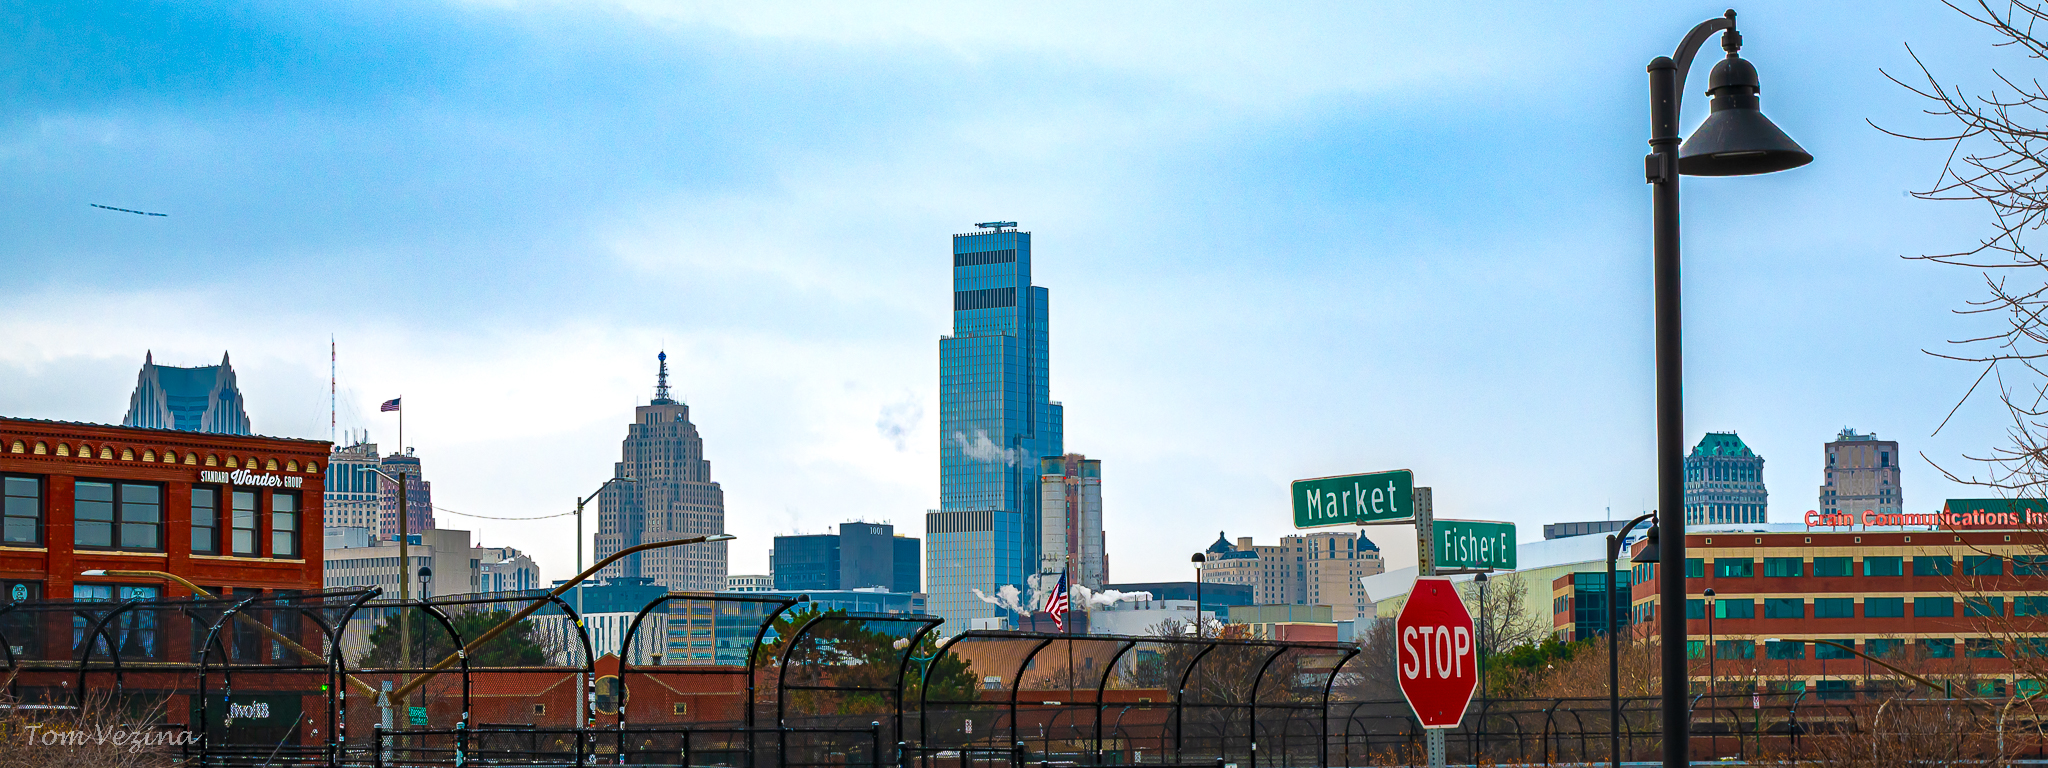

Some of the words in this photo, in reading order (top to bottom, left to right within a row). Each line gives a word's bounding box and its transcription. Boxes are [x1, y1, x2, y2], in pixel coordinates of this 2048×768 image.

[201, 470, 229, 484] STANDARD
[230, 469, 283, 487] Wonder
[284, 476, 303, 488] GROUP
[1306, 480, 1398, 520] Market
[870, 526, 883, 536] 1001
[1804, 509, 1855, 527] Crain
[1861, 508, 2019, 527] Communications
[2025, 508, 2048, 525] In
[1444, 528, 1496, 563] Fisher
[1501, 533, 1507, 563] E
[1403, 625, 1470, 679] STOP
